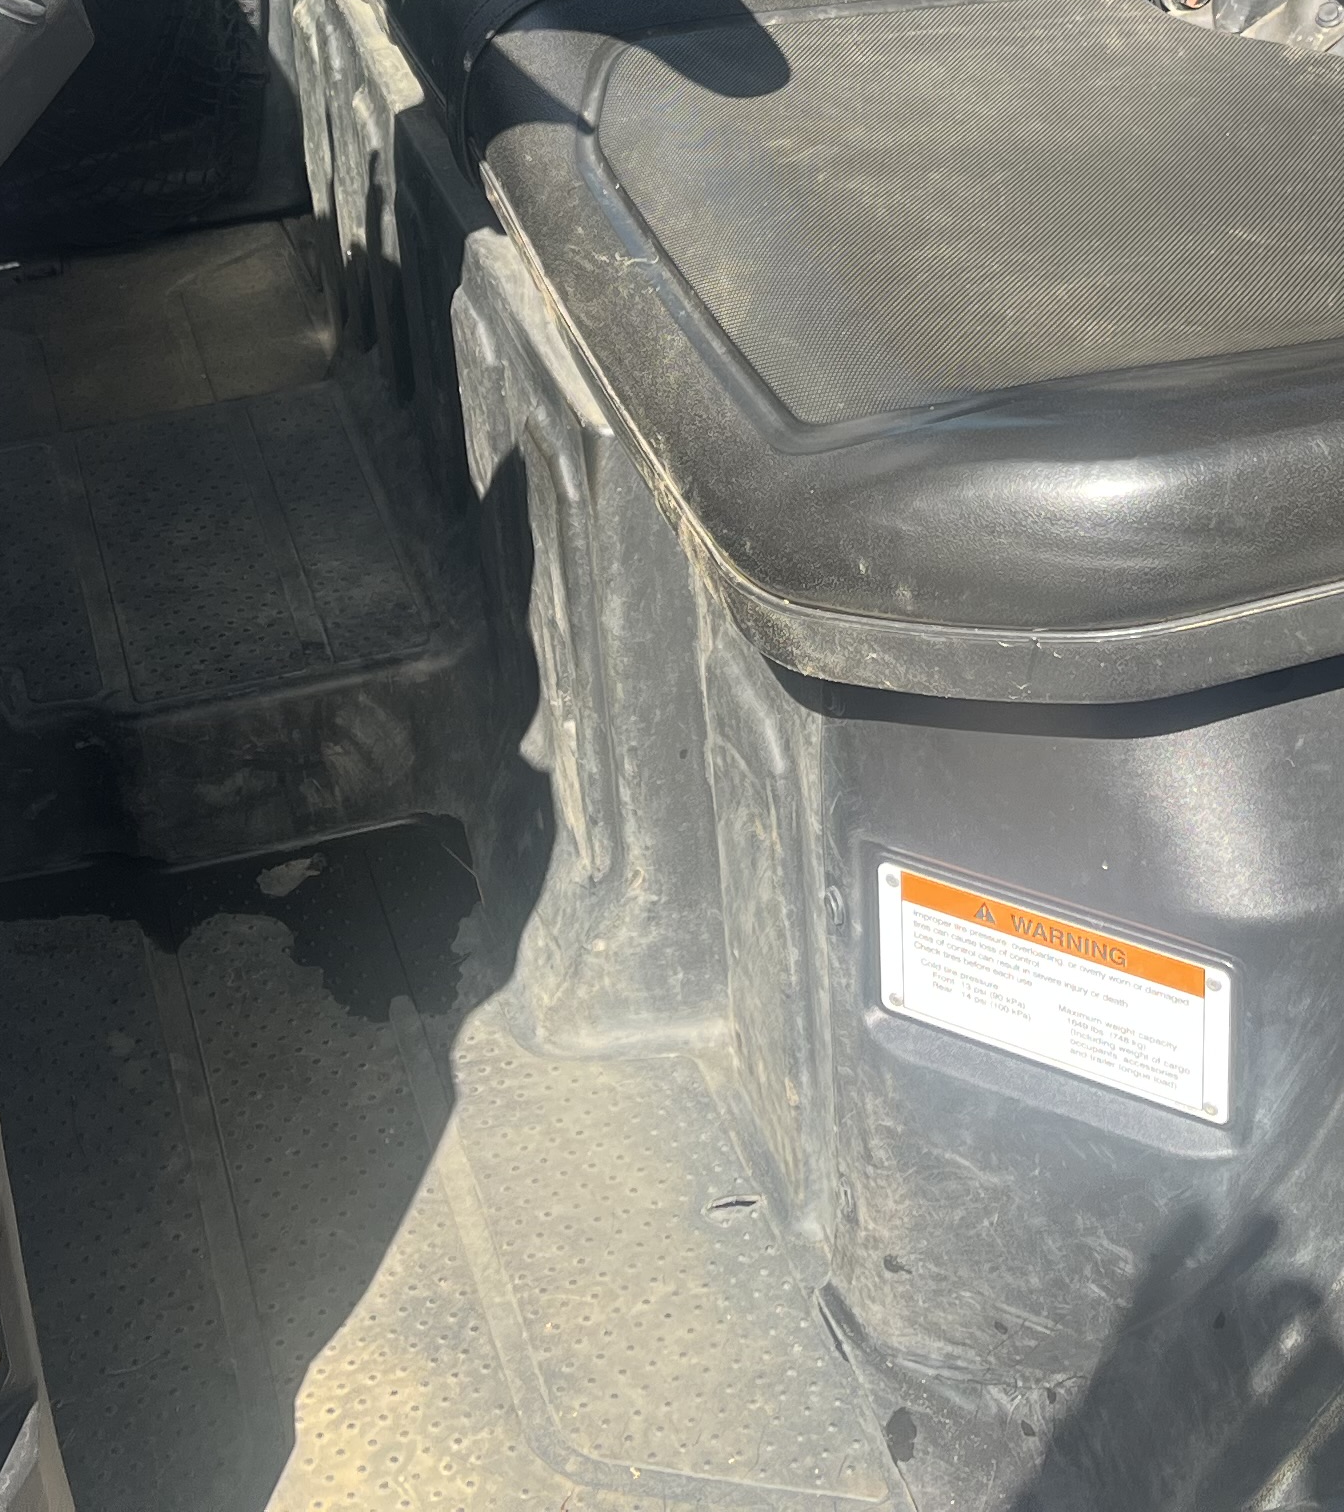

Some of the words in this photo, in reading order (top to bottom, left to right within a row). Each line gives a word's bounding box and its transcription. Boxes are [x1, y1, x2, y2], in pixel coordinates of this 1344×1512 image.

[912, 919, 931, 932] tires
[932, 927, 950, 937] can
[950, 933, 977, 948] cause
[978, 941, 997, 954] loss
[1011, 914, 1126, 967] WARNING
[913, 940, 941, 956] Check
[942, 950, 962, 963] tires
[963, 957, 991, 973] before
[992, 968, 1015, 980] each
[913, 931, 934, 944] Loss
[946, 942, 976, 957] control
[977, 953, 995, 963] can
[996, 959, 1021, 972] result
[1032, 971, 1062, 987] severe
[1064, 981, 1089, 997] injury
[943, 966, 958, 976] tire
[953, 923, 968, 933] tire
[1079, 965, 1107, 981] overly
[1108, 975, 1131, 987] worn
[1144, 986, 1190, 1006] damaged
[1058, 1003, 1103, 1025] Maximum
[1104, 1022, 1136, 1037] weight
[1069, 1047, 1088, 1059] and
[1089, 1053, 1115, 1068] trailer
[1118, 1063, 1151, 1080] tongue
[1118, 1046, 1149, 1061] weight
